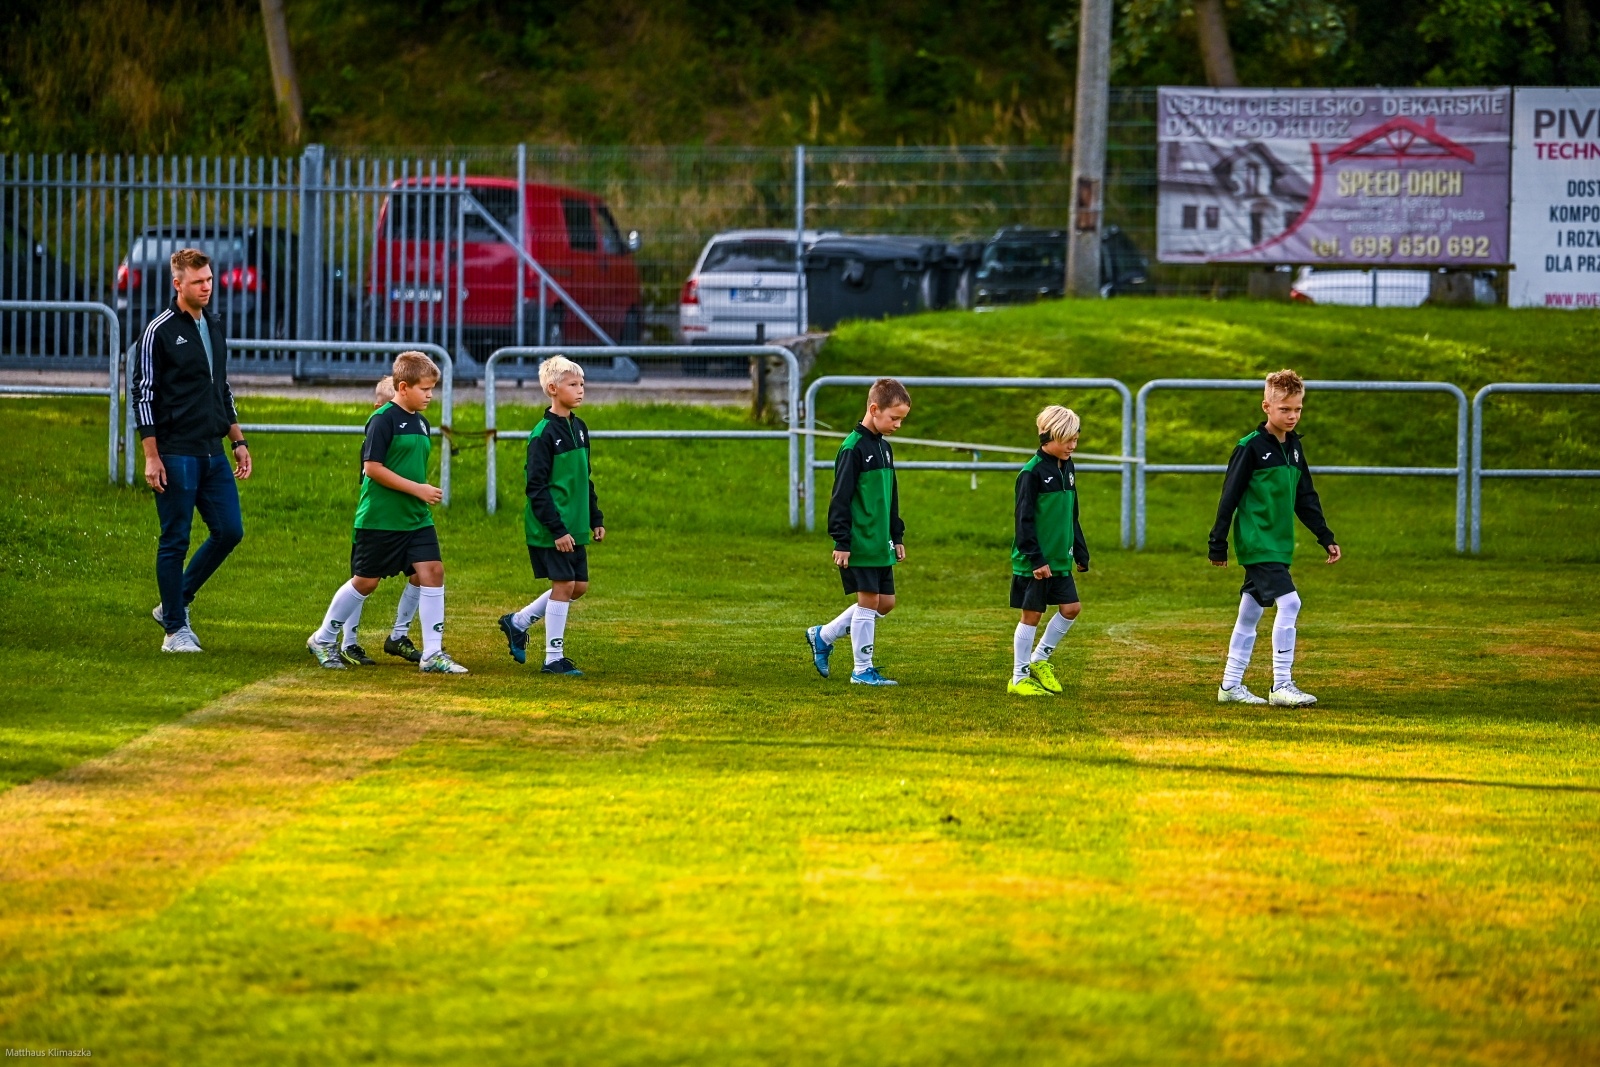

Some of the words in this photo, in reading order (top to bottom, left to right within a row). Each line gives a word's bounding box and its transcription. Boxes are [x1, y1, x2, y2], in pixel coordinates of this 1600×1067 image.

[1245, 98, 1366, 117] CIESIELSKO
[1382, 95, 1504, 116] DEKARSKIE
[1165, 118, 1227, 137] DOMY
[1233, 119, 1278, 138] POD
[1534, 108, 1600, 139] PIV
[1352, 235, 1393, 257] 698
[1399, 235, 1441, 257] 650
[1447, 235, 1490, 258] 692
[1545, 254, 1572, 273] DLA
